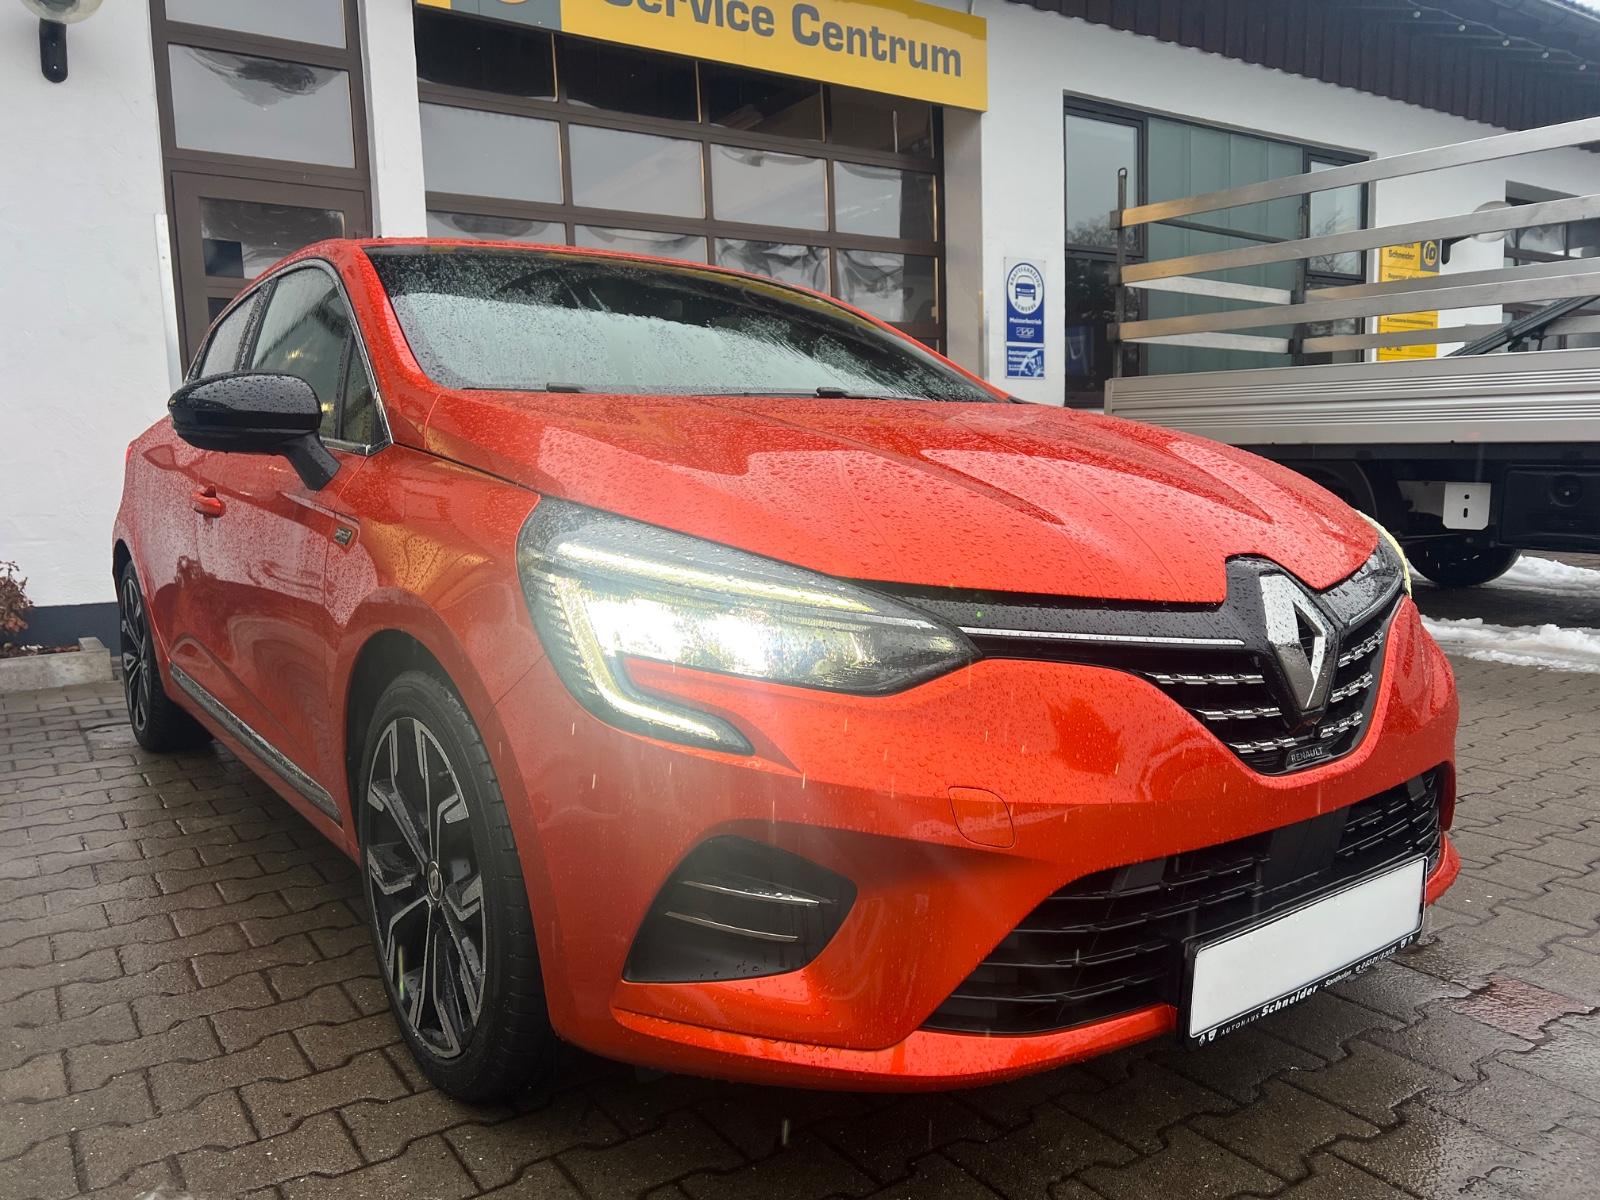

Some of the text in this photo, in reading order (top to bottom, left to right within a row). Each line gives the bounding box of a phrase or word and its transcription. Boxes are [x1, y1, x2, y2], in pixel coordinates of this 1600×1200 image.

[604, 0, 962, 77] rvice Centrum
[1291, 747, 1323, 762] RENAULT
[1261, 984, 1319, 1017] Schneider
